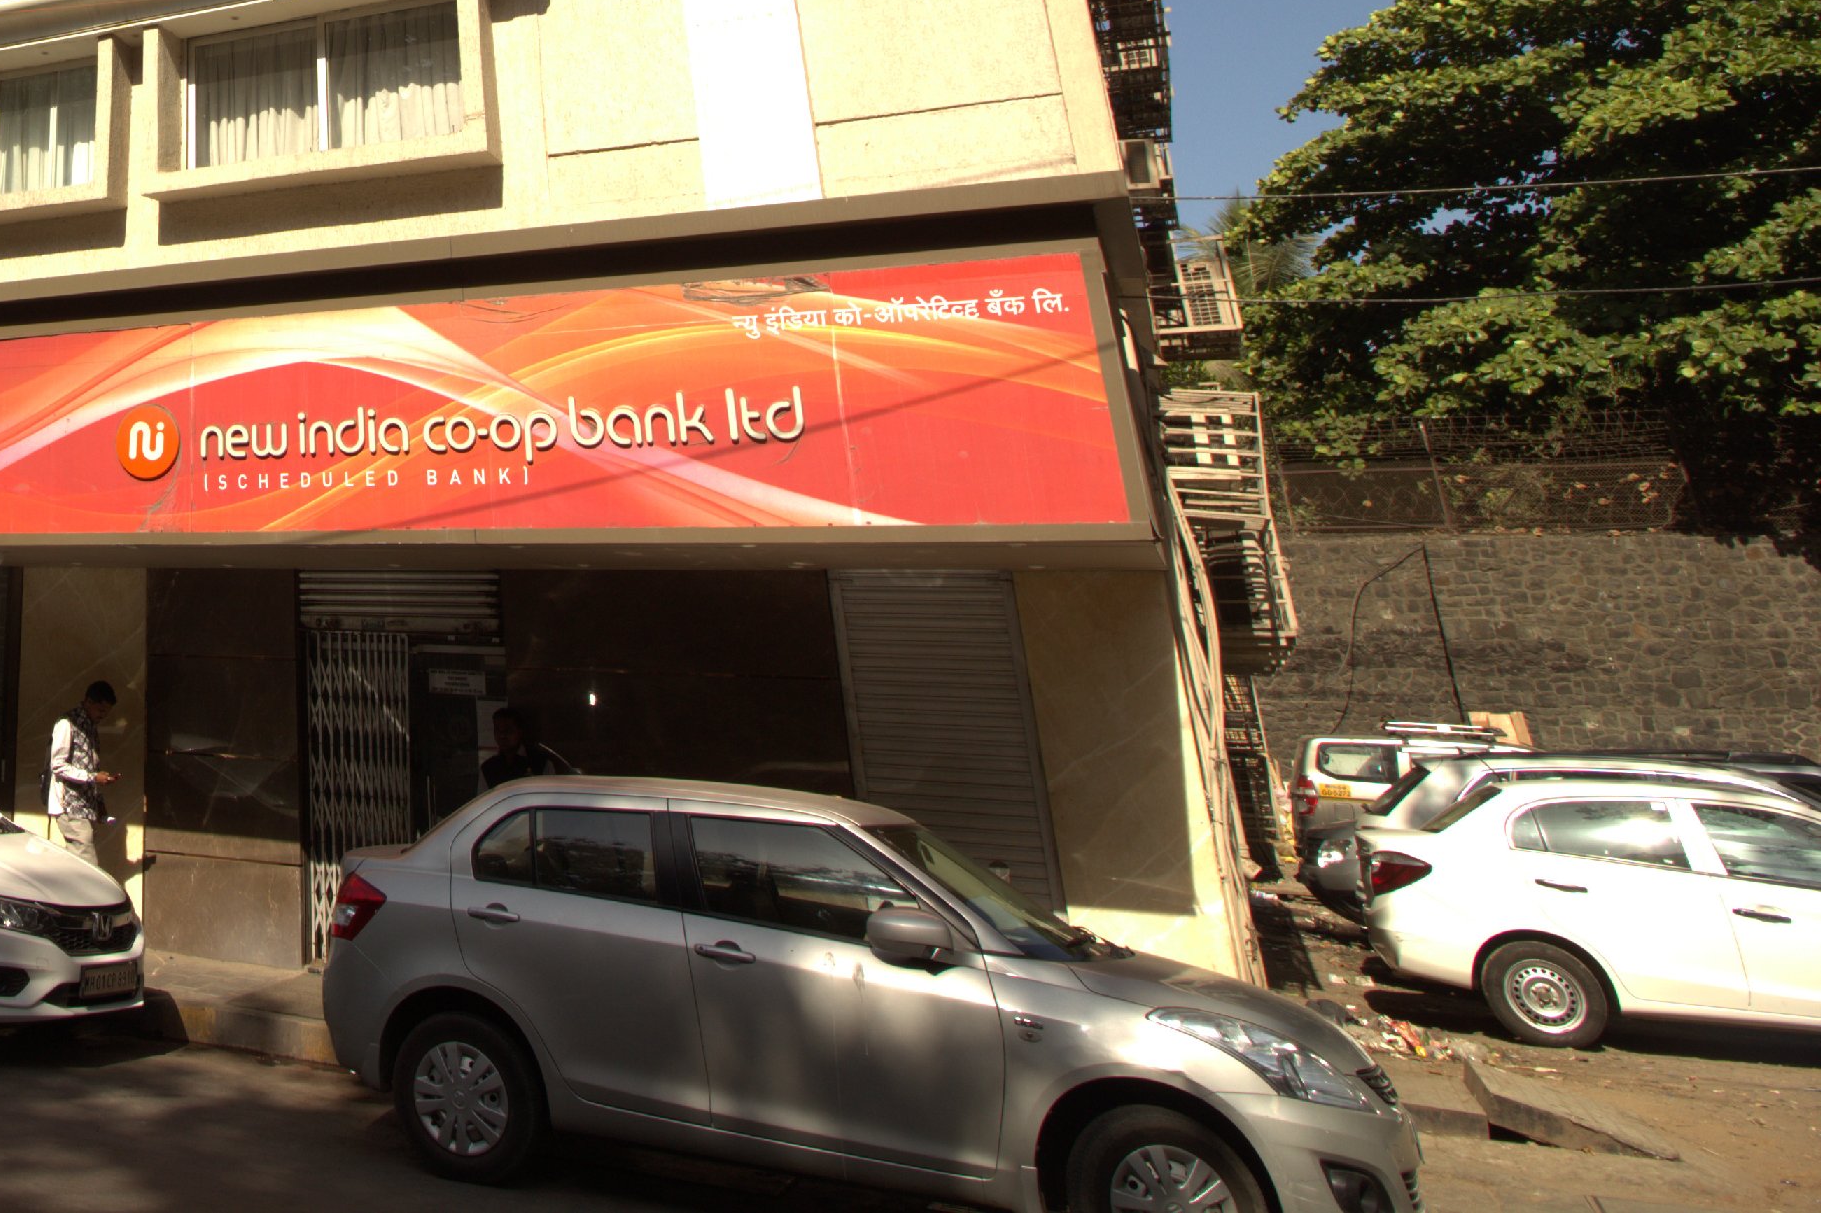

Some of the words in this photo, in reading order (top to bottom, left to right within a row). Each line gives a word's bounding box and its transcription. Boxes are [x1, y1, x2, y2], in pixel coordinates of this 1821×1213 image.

[765, 306, 827, 335] इंडिया
[1030, 287, 1070, 314] लि.
[200, 421, 288, 459] new
[298, 406, 410, 457] india
[422, 409, 558, 465] co-op
[568, 390, 713, 449] bank
[724, 385, 805, 443] ltd
